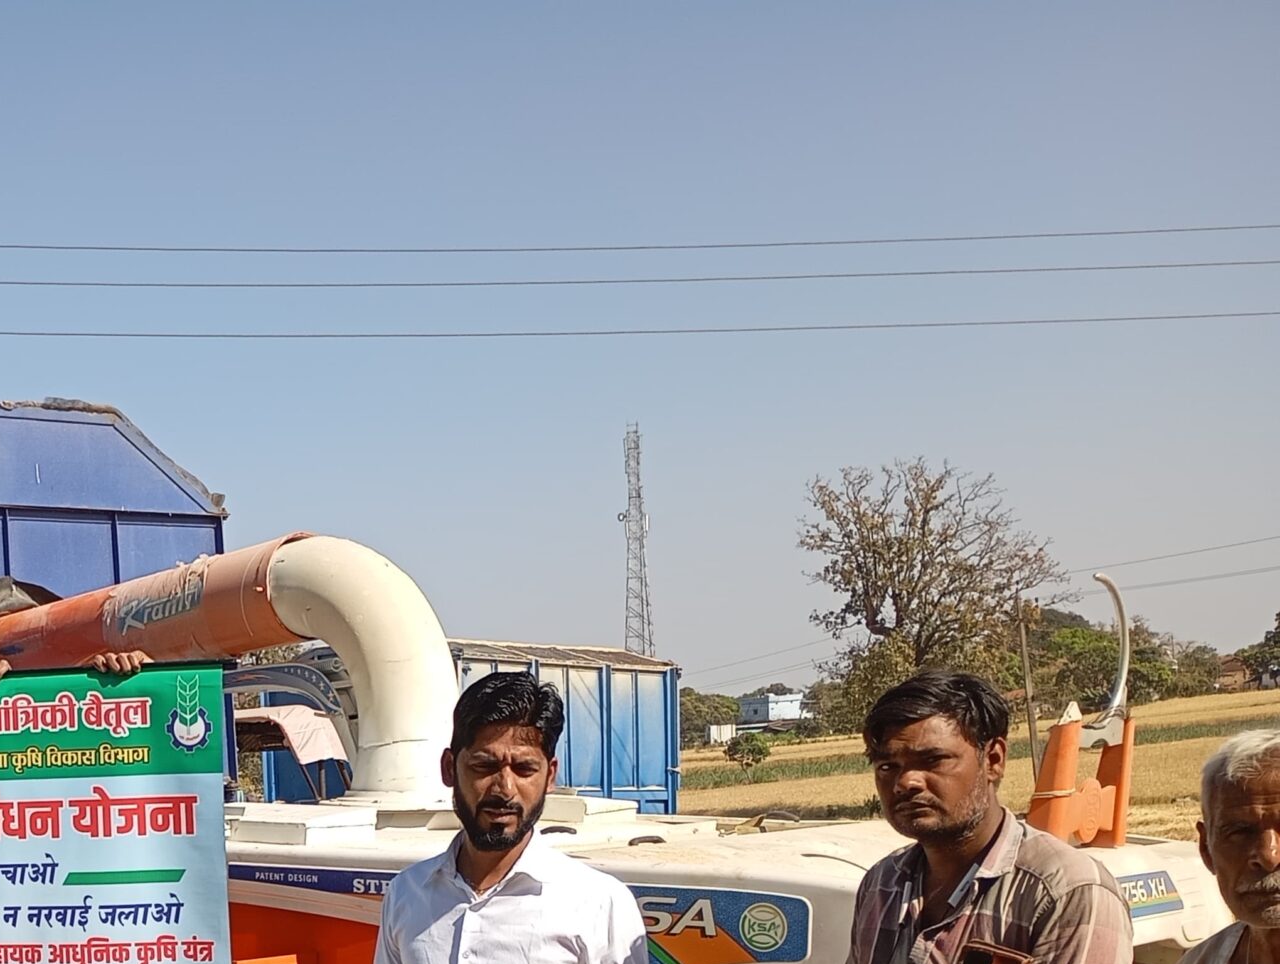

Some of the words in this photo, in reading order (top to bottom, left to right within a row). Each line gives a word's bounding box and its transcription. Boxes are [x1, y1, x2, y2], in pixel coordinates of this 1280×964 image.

[81, 691, 151, 737] बैतूल
[11, 747, 42, 773] कृषि
[46, 746, 94, 767] विकास
[99, 744, 150, 765] विभाग
[69, 786, 197, 838] योजना
[255, 872, 284, 881] PATENT
[288, 873, 319, 883] DESIGN
[1121, 880, 1147, 902] 756
[4, 906, 21, 927] न
[28, 895, 93, 932] नरवाई
[98, 893, 184, 926] जलाओ
[635, 896, 718, 937] SA
[747, 921, 781, 937] KSA
[181, 935, 214, 962] यंत्र
